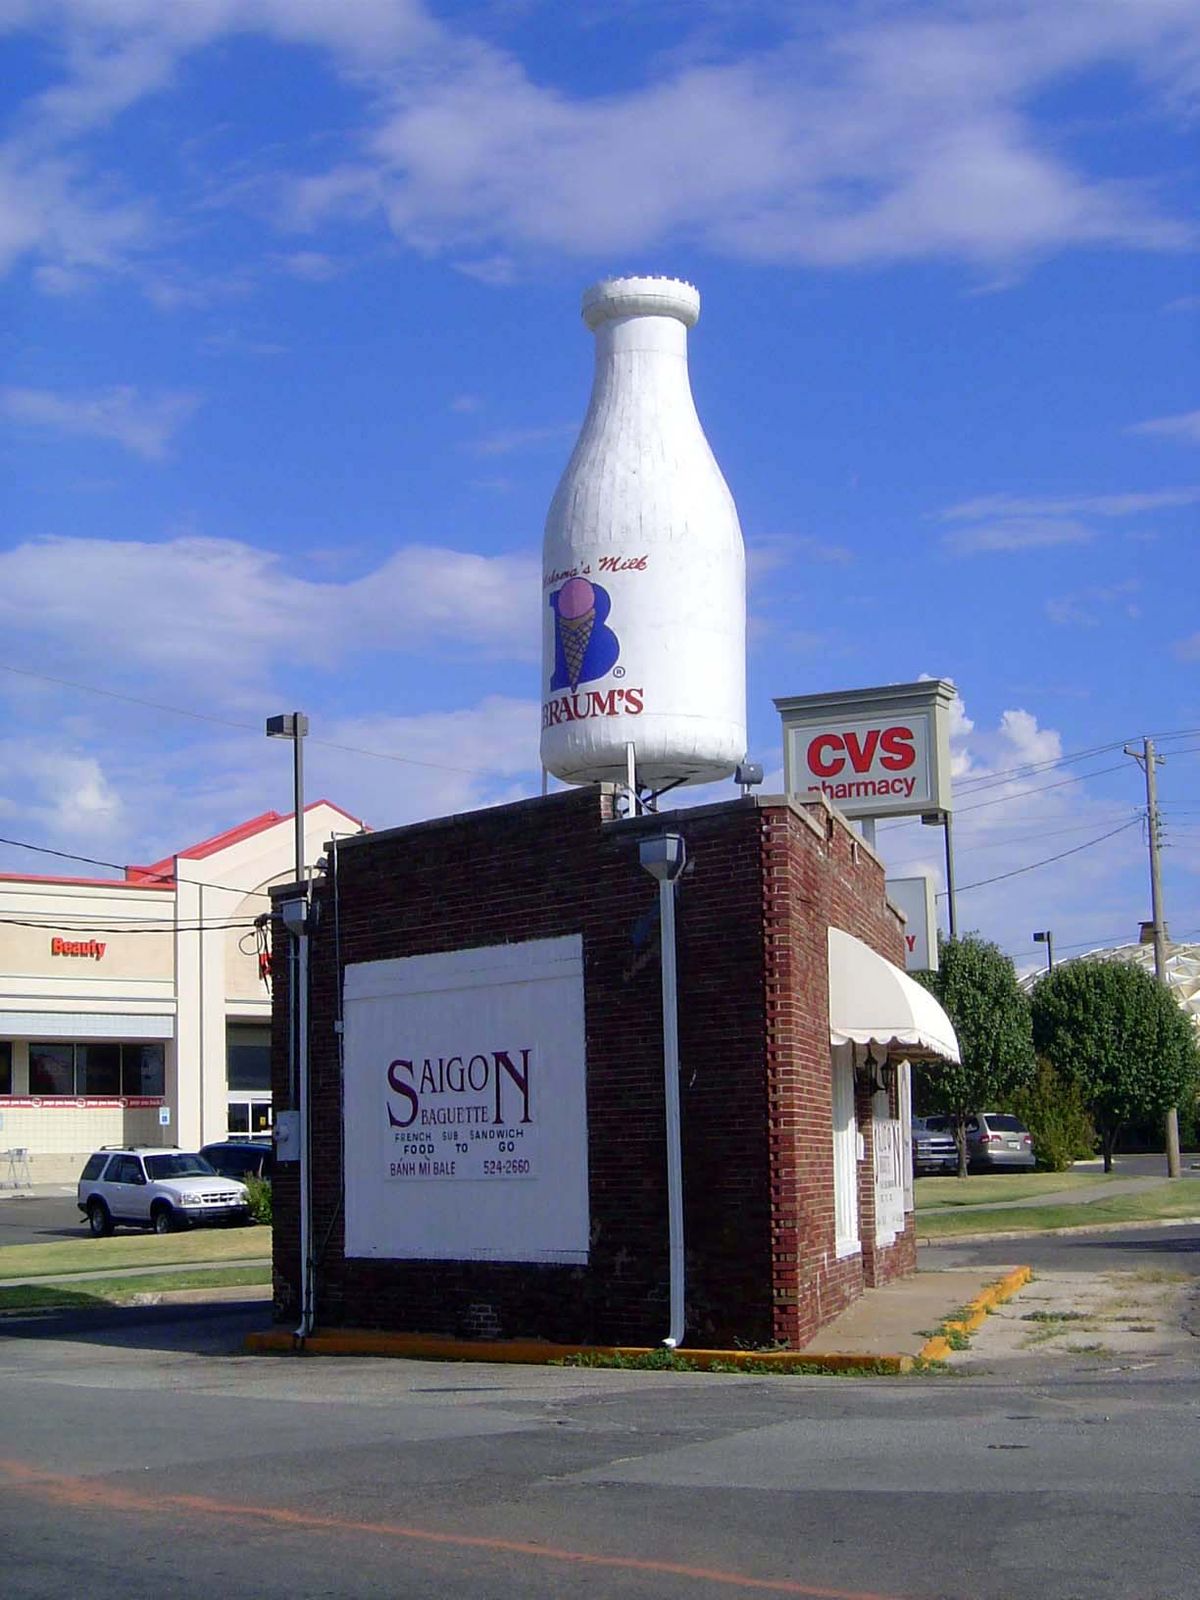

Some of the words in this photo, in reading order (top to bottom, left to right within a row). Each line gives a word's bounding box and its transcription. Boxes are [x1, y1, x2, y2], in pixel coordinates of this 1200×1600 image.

[598, 555, 648, 572] Milk
[542, 688, 644, 729] BRAUM'S
[807, 726, 916, 777] CVS
[51, 937, 107, 961] Beauty
[386, 1049, 533, 1128] SAIGON
[421, 1106, 489, 1126] BAGUETTE
[395, 1132, 432, 1142] FRENCH
[442, 1131, 459, 1141] SUB
[470, 1129, 524, 1140] SANDWICH
[404, 1144, 435, 1154] FOOD
[455, 1143, 469, 1153] TO
[498, 1141, 515, 1152] GO
[433, 1161, 456, 1175] BALE
[483, 1160, 530, 1175] 524-2660
